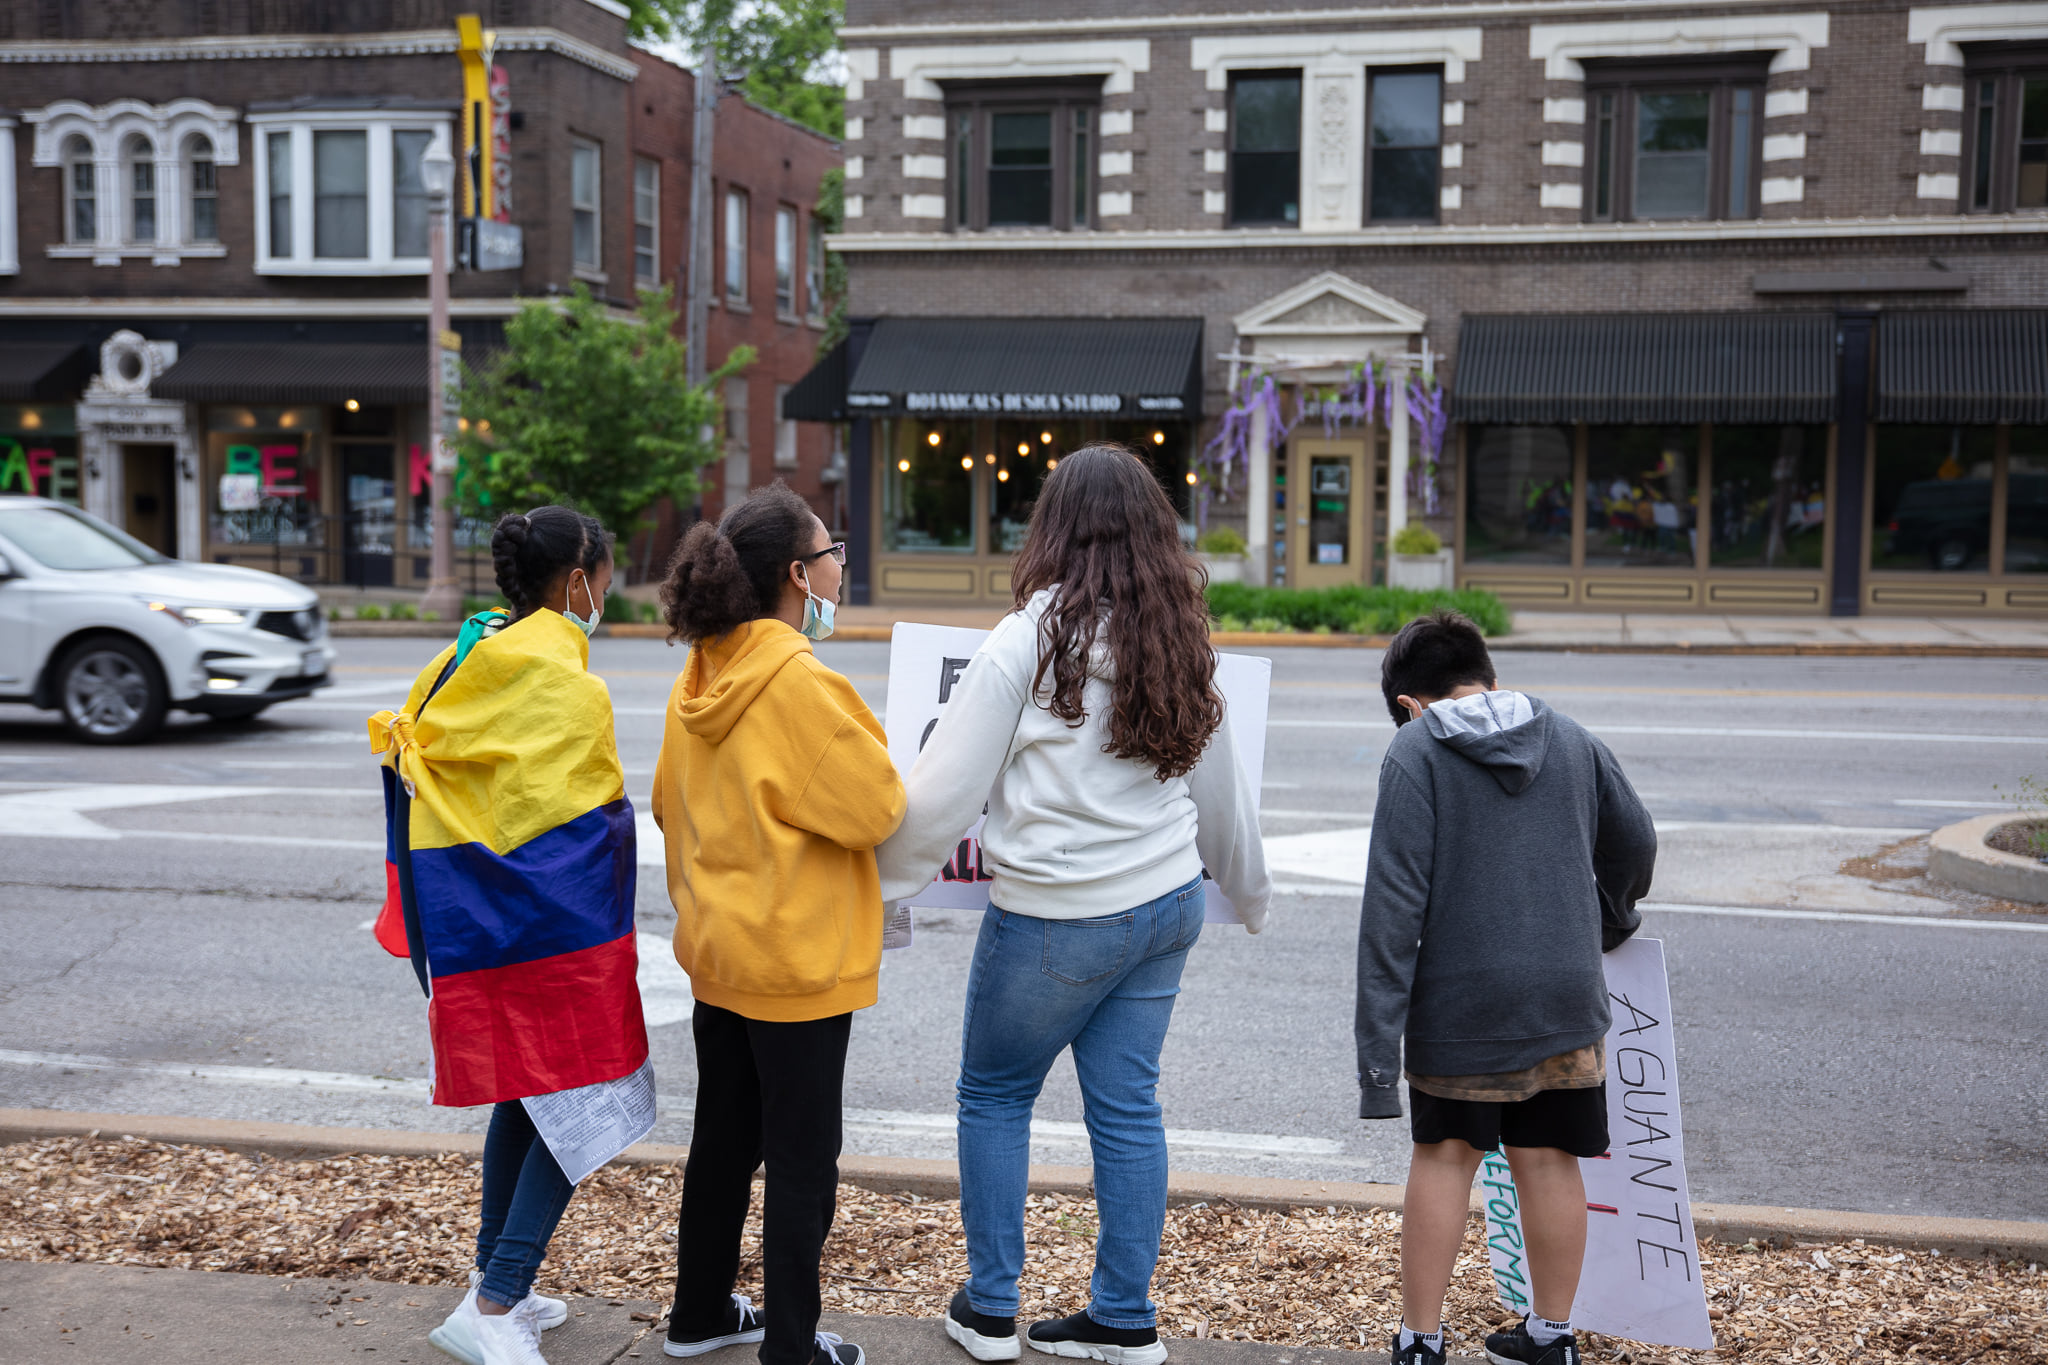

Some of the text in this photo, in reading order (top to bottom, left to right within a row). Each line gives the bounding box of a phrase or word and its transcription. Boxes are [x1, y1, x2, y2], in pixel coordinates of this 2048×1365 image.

[491, 84, 513, 214] SALON
[1062, 393, 1122, 412] STUDIO
[227, 444, 300, 496] BE
[1608, 992, 1691, 1282] AGUANTE
